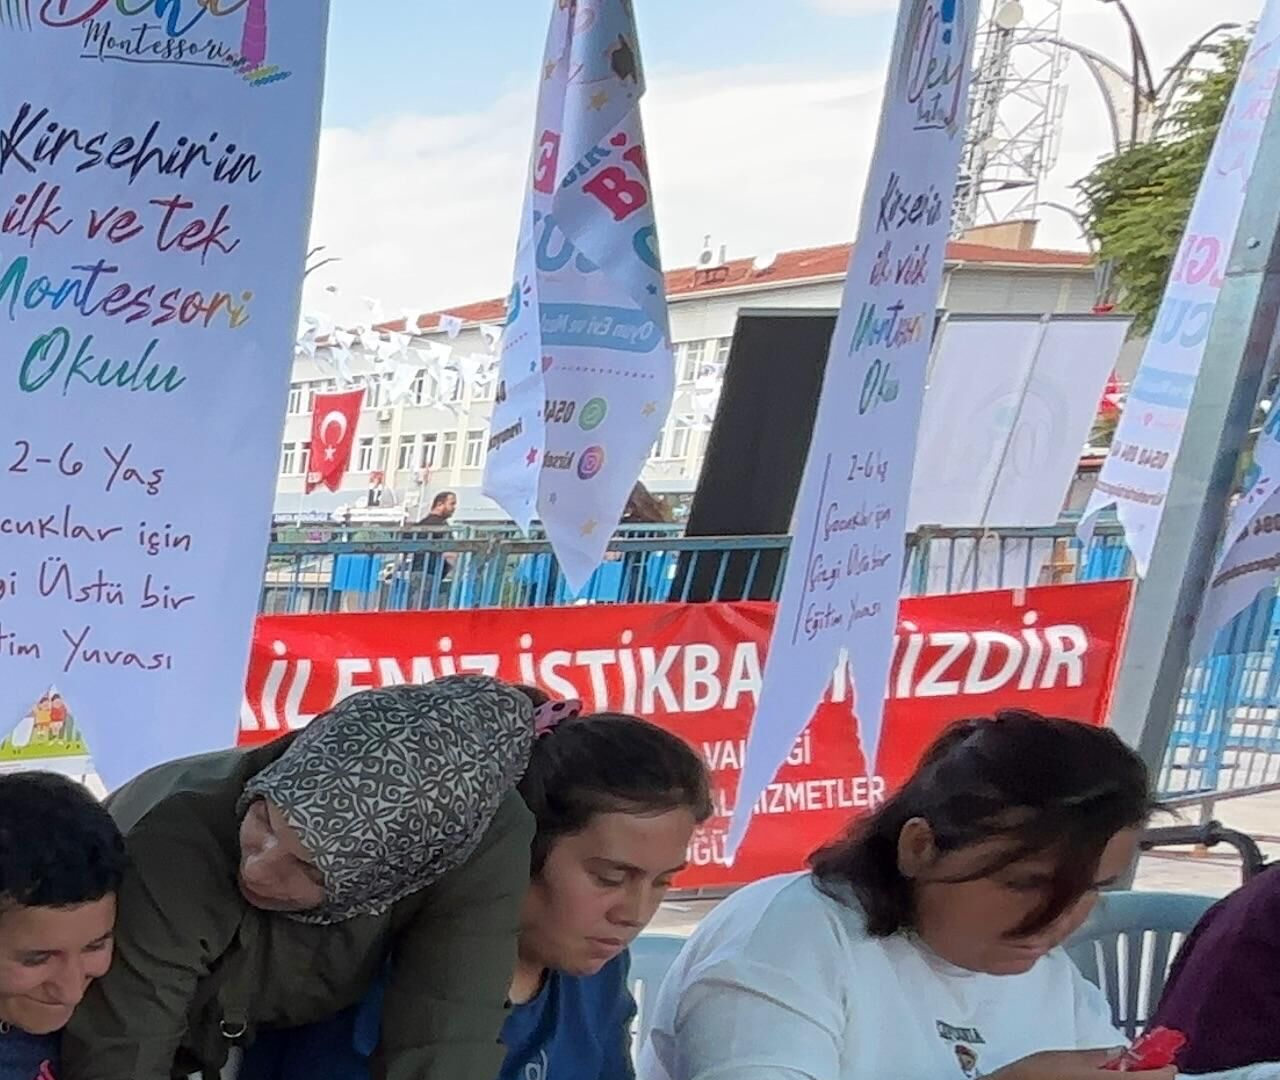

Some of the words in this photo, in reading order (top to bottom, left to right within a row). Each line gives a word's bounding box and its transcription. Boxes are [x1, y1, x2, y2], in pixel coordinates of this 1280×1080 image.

[82, 19, 230, 61] Montessori
[2, 182, 73, 248] ilk
[88, 205, 144, 243] ve
[149, 195, 241, 265] tek
[18, 326, 187, 396] Okulu
[8, 440, 83, 476] 2-6
[103, 443, 165, 495] Yaş
[139, 521, 191, 556] için
[40, 556, 124, 602] Üstü
[141, 575, 196, 610] bir
[62, 626, 172, 672] Yuvası
